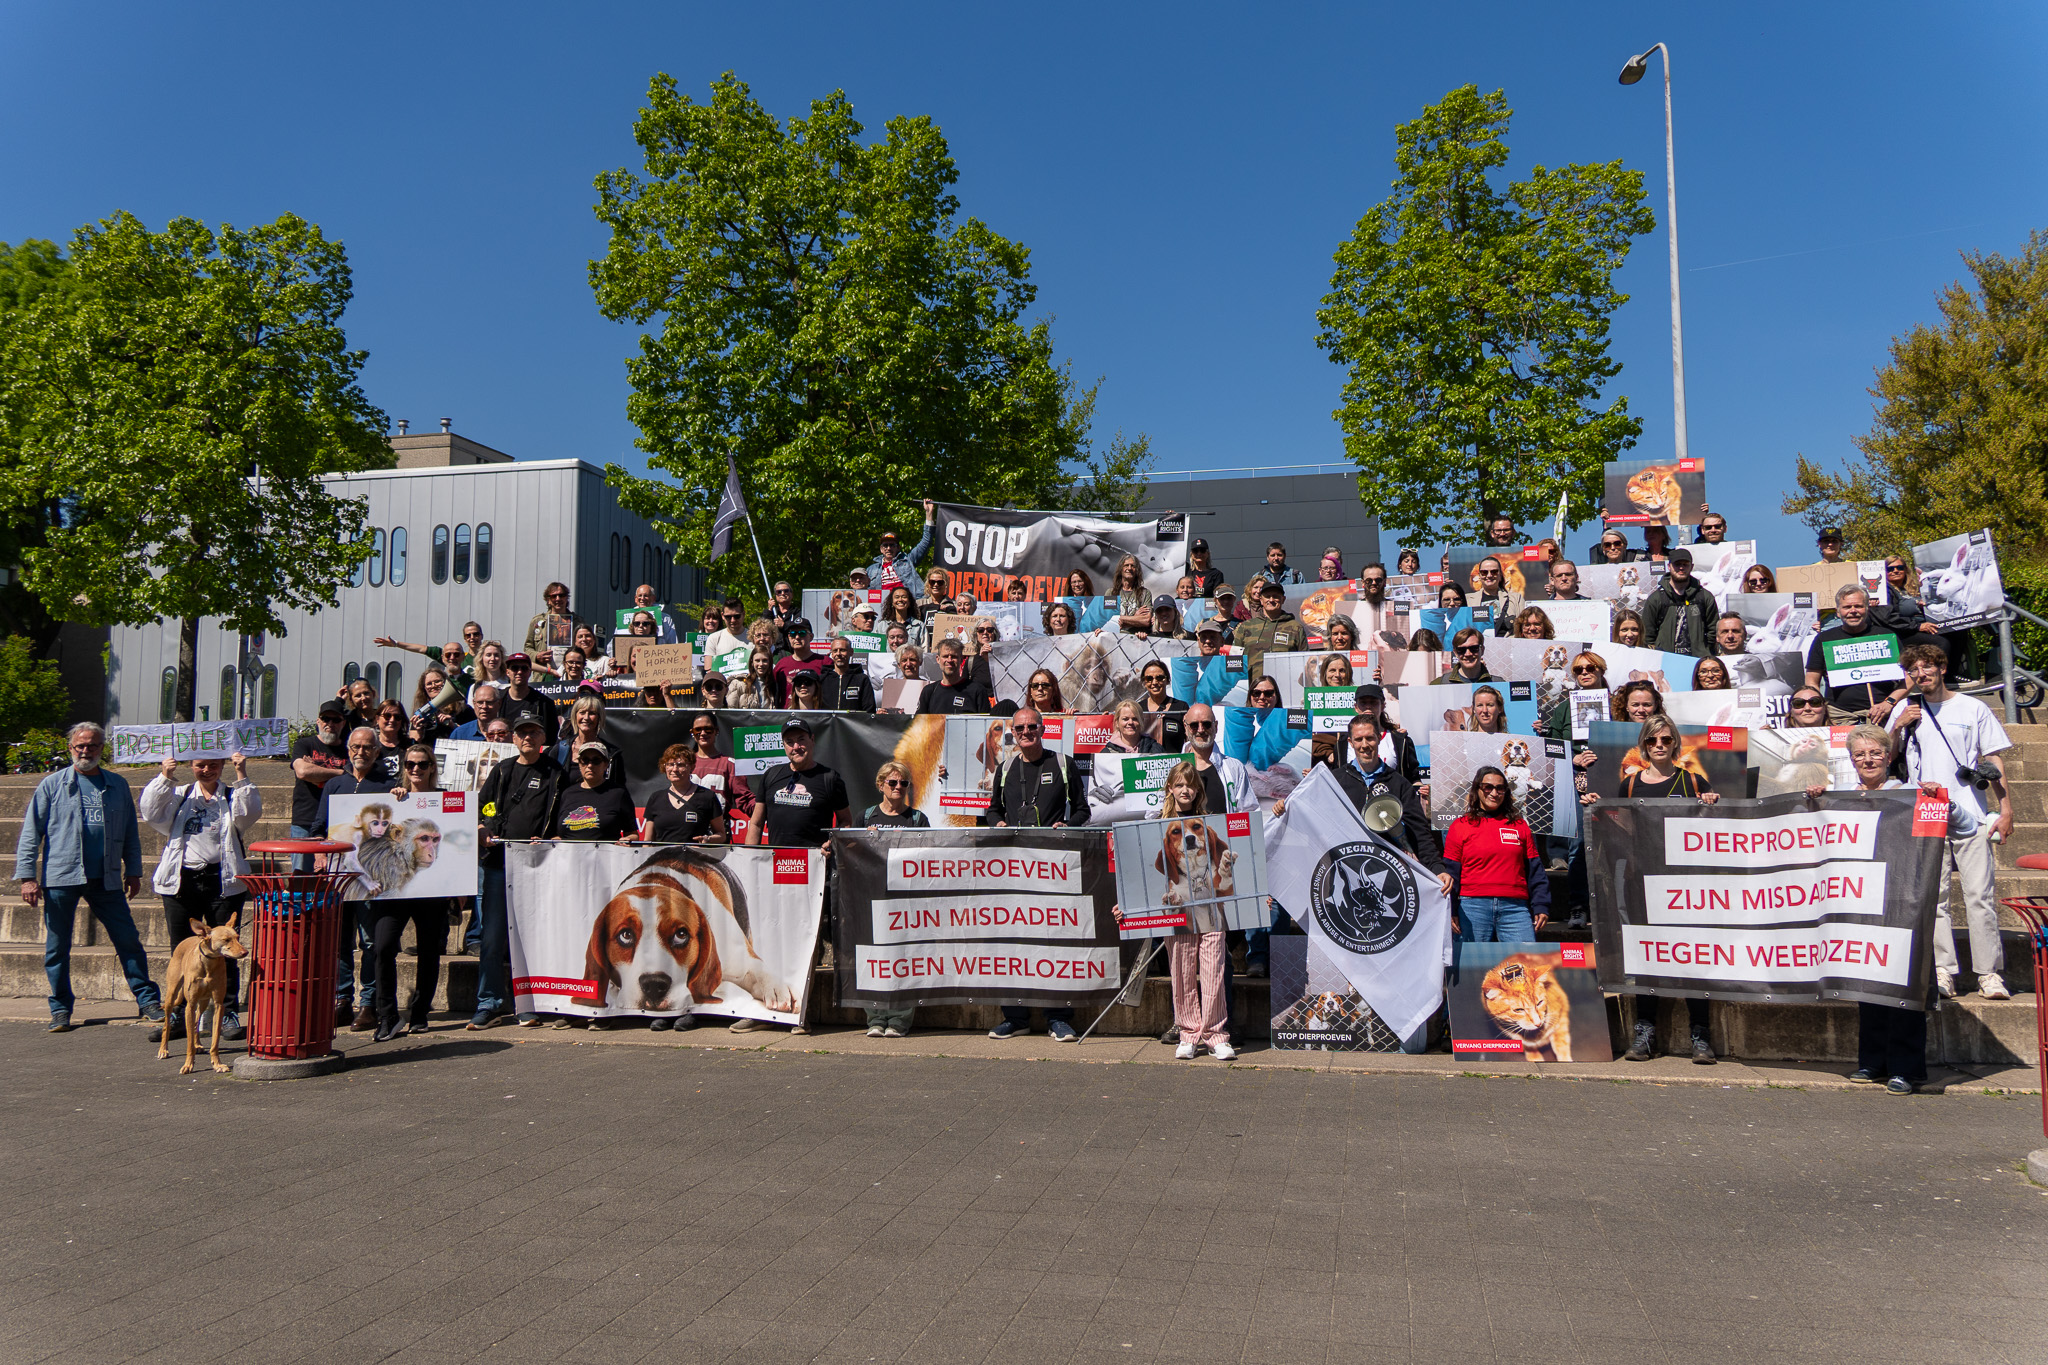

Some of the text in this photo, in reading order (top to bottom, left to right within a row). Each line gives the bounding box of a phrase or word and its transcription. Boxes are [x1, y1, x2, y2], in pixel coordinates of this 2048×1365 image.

[943, 520, 1029, 568] STOP
[944, 570, 1069, 602] DIERPROEV
[643, 649, 680, 658] BARRY
[1832, 640, 1889, 655] PROEFDIEREN?
[1834, 648, 1892, 664] ACHTERHAALD!
[638, 670, 650, 678] WE
[671, 667, 691, 676] HERE!
[602, 678, 636, 687] dieren
[564, 685, 579, 694] ver
[670, 687, 695, 696] even!
[1307, 693, 1323, 701] STOP
[1310, 700, 1356, 709] KIES MEDEDOG
[744, 733, 761, 743] STOP
[1076, 728, 1112, 736] ANIMAL
[1078, 735, 1110, 743] RIGHTS
[744, 740, 784, 752] OP DIERENLE
[1145, 769, 1170, 780] ZONDE
[1135, 778, 1166, 790] SLACHTO
[1919, 803, 1949, 811] ANIM
[1921, 811, 1948, 820] RIGH
[1684, 823, 1859, 854] DIERPROEVEN
[902, 858, 1068, 880] DIERPROEVEN
[1313, 864, 1326, 890] AGAINST
[1339, 845, 1416, 922] VEGAN STRIKE GROUP
[1667, 876, 1864, 910] ZIJN MISDADEN
[1313, 892, 1323, 918] ANIMAL
[888, 906, 1079, 931] ZIJN MISDADEN
[1148, 917, 1185, 925] DIERPROEVEN
[1321, 918, 1342, 939] ABUSE
[1345, 934, 1397, 952] ENTERTAINMENT
[1639, 940, 1735, 966] TEGEN
[867, 956, 1105, 979] TEGEN WEERLOZEN
[516, 981, 594, 993] VERVANG DIERPROEVEN
[1277, 1032, 1352, 1041] STOP DIERPROEVEN
